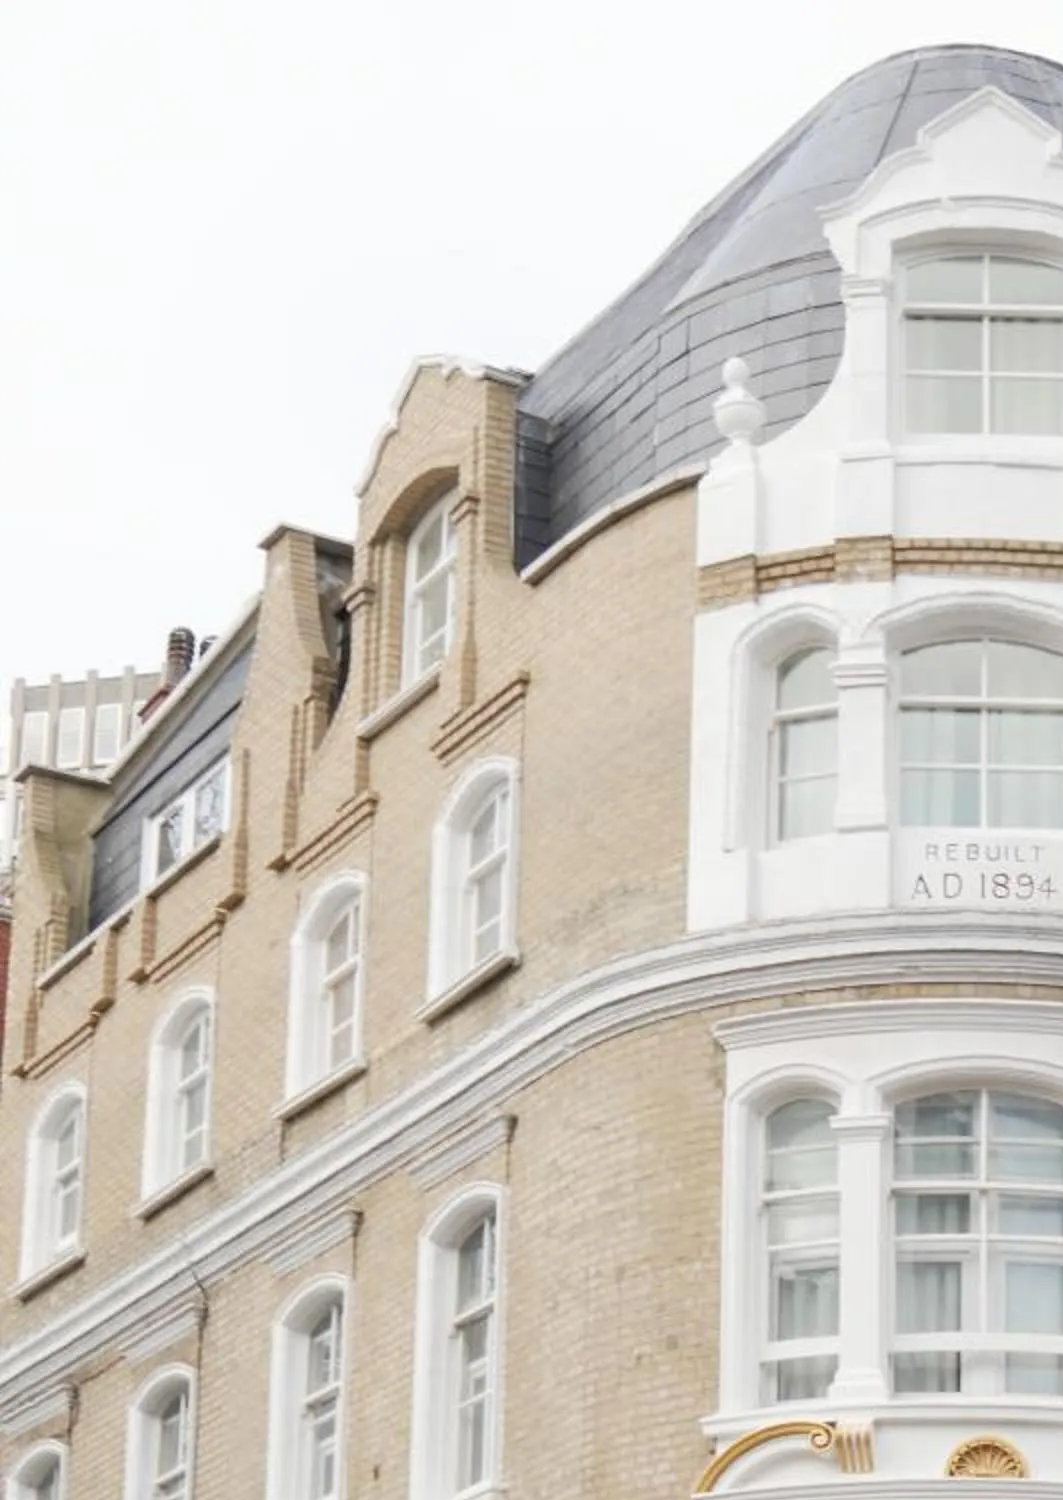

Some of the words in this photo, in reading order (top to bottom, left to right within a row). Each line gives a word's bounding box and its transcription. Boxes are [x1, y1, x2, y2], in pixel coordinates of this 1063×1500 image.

[925, 843, 1044, 862] REBUILT
[912, 873, 963, 899] AD
[981, 873, 1058, 899] 1894
